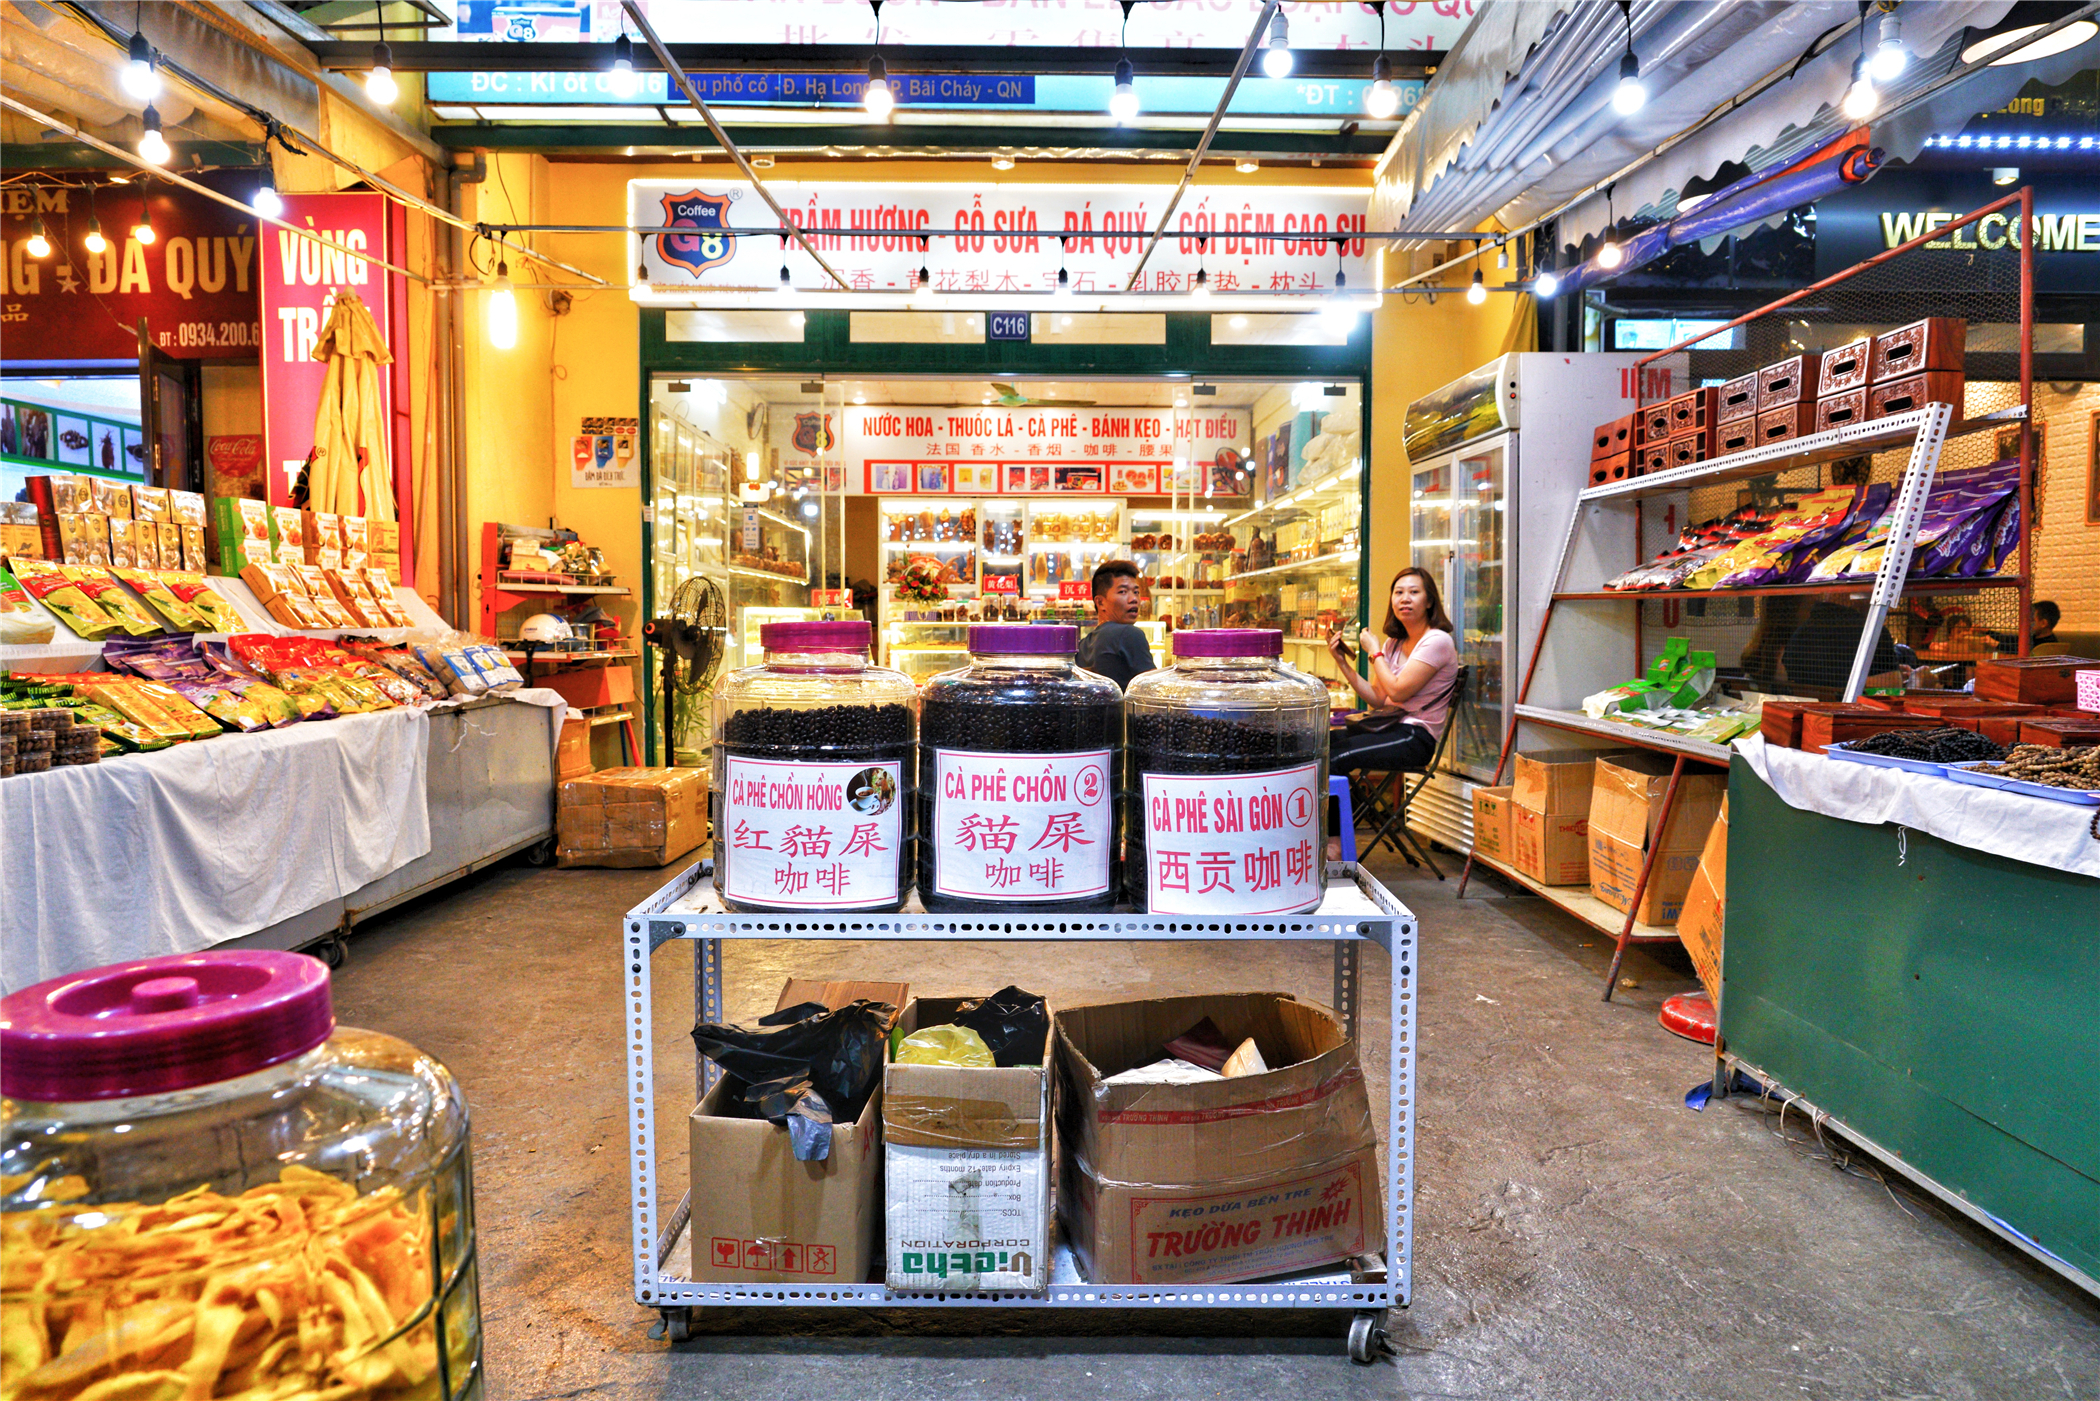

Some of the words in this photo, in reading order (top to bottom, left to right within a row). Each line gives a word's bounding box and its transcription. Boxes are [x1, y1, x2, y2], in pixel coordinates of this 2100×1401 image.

[471, 72, 508, 92] ĐC
[712, 74, 744, 96] phố
[805, 79, 827, 99] Hạ
[910, 79, 936, 96] Bãi
[940, 79, 982, 100] Cháy
[997, 81, 1022, 98] QN
[1997, 98, 2045, 117] ong
[677, 204, 717, 217] Coffee
[670, 218, 724, 260] G8
[778, 193, 842, 252] TRẦM
[851, 204, 930, 253] HƯƠNG
[954, 193, 985, 254] GỖ
[994, 206, 1040, 254] SƯA
[1063, 201, 1095, 254] ĐÁ
[1103, 202, 1148, 260] QUÝ
[1179, 196, 1217, 262] GỐI
[1224, 203, 1275, 266] ĐỆM
[1284, 212, 1328, 257] CAO
[1336, 213, 1366, 258] SU
[1881, 212, 2100, 251] WELCOME
[165, 225, 256, 300] QUÝ
[278, 216, 368, 286] VÒNG
[992, 316, 1025, 335] C116
[863, 411, 901, 437] NƯỚC
[905, 417, 934, 437] HOA
[947, 409, 993, 437] THUỐC
[997, 413, 1014, 437] LÁ
[1028, 413, 1046, 437] CÀ
[1051, 413, 1078, 437] PHÊ
[1091, 413, 1130, 438] BÁNH
[1134, 418, 1161, 443] KẸO
[1176, 419, 1201, 443] HẠT
[925, 442, 960, 457] 法国
[970, 442, 1005, 457] 香水
[1027, 443, 1062, 457] 香烟
[1083, 443, 1118, 457] 咖啡
[732, 772, 745, 806] CÀ
[747, 775, 767, 808] PHÊ
[769, 771, 803, 811] CHỒN
[806, 772, 843, 811] HỒNG
[945, 766, 966, 800] CÀ
[971, 767, 1007, 802] PHÊ
[1012, 763, 1067, 803] CHỒN
[1152, 789, 1172, 832] CÀ
[1176, 790, 1209, 833] PHÊ
[1213, 789, 1244, 834] SÀI
[1249, 786, 1283, 832] GÒN
[774, 861, 852, 897] 咖啡
[985, 856, 1065, 889] 咖啡
[1156, 839, 1313, 895] 西贡咖啡
[939, 1164, 966, 1173] months
[968, 1150, 980, 1160] dry
[989, 1151, 996, 1160] in
[998, 1151, 1021, 1160] Stored
[999, 1163, 1021, 1173] Expiry
[985, 1179, 1021, 1188] Production
[1169, 1207, 1204, 1220] KẸO
[1246, 1192, 1279, 1210] BẾN
[1284, 1187, 1313, 1200] TRE
[901, 1238, 1030, 1249] CORPORATION
[1147, 1219, 1261, 1258] TRƯỜNG
[1271, 1197, 1351, 1238] THỊNH
